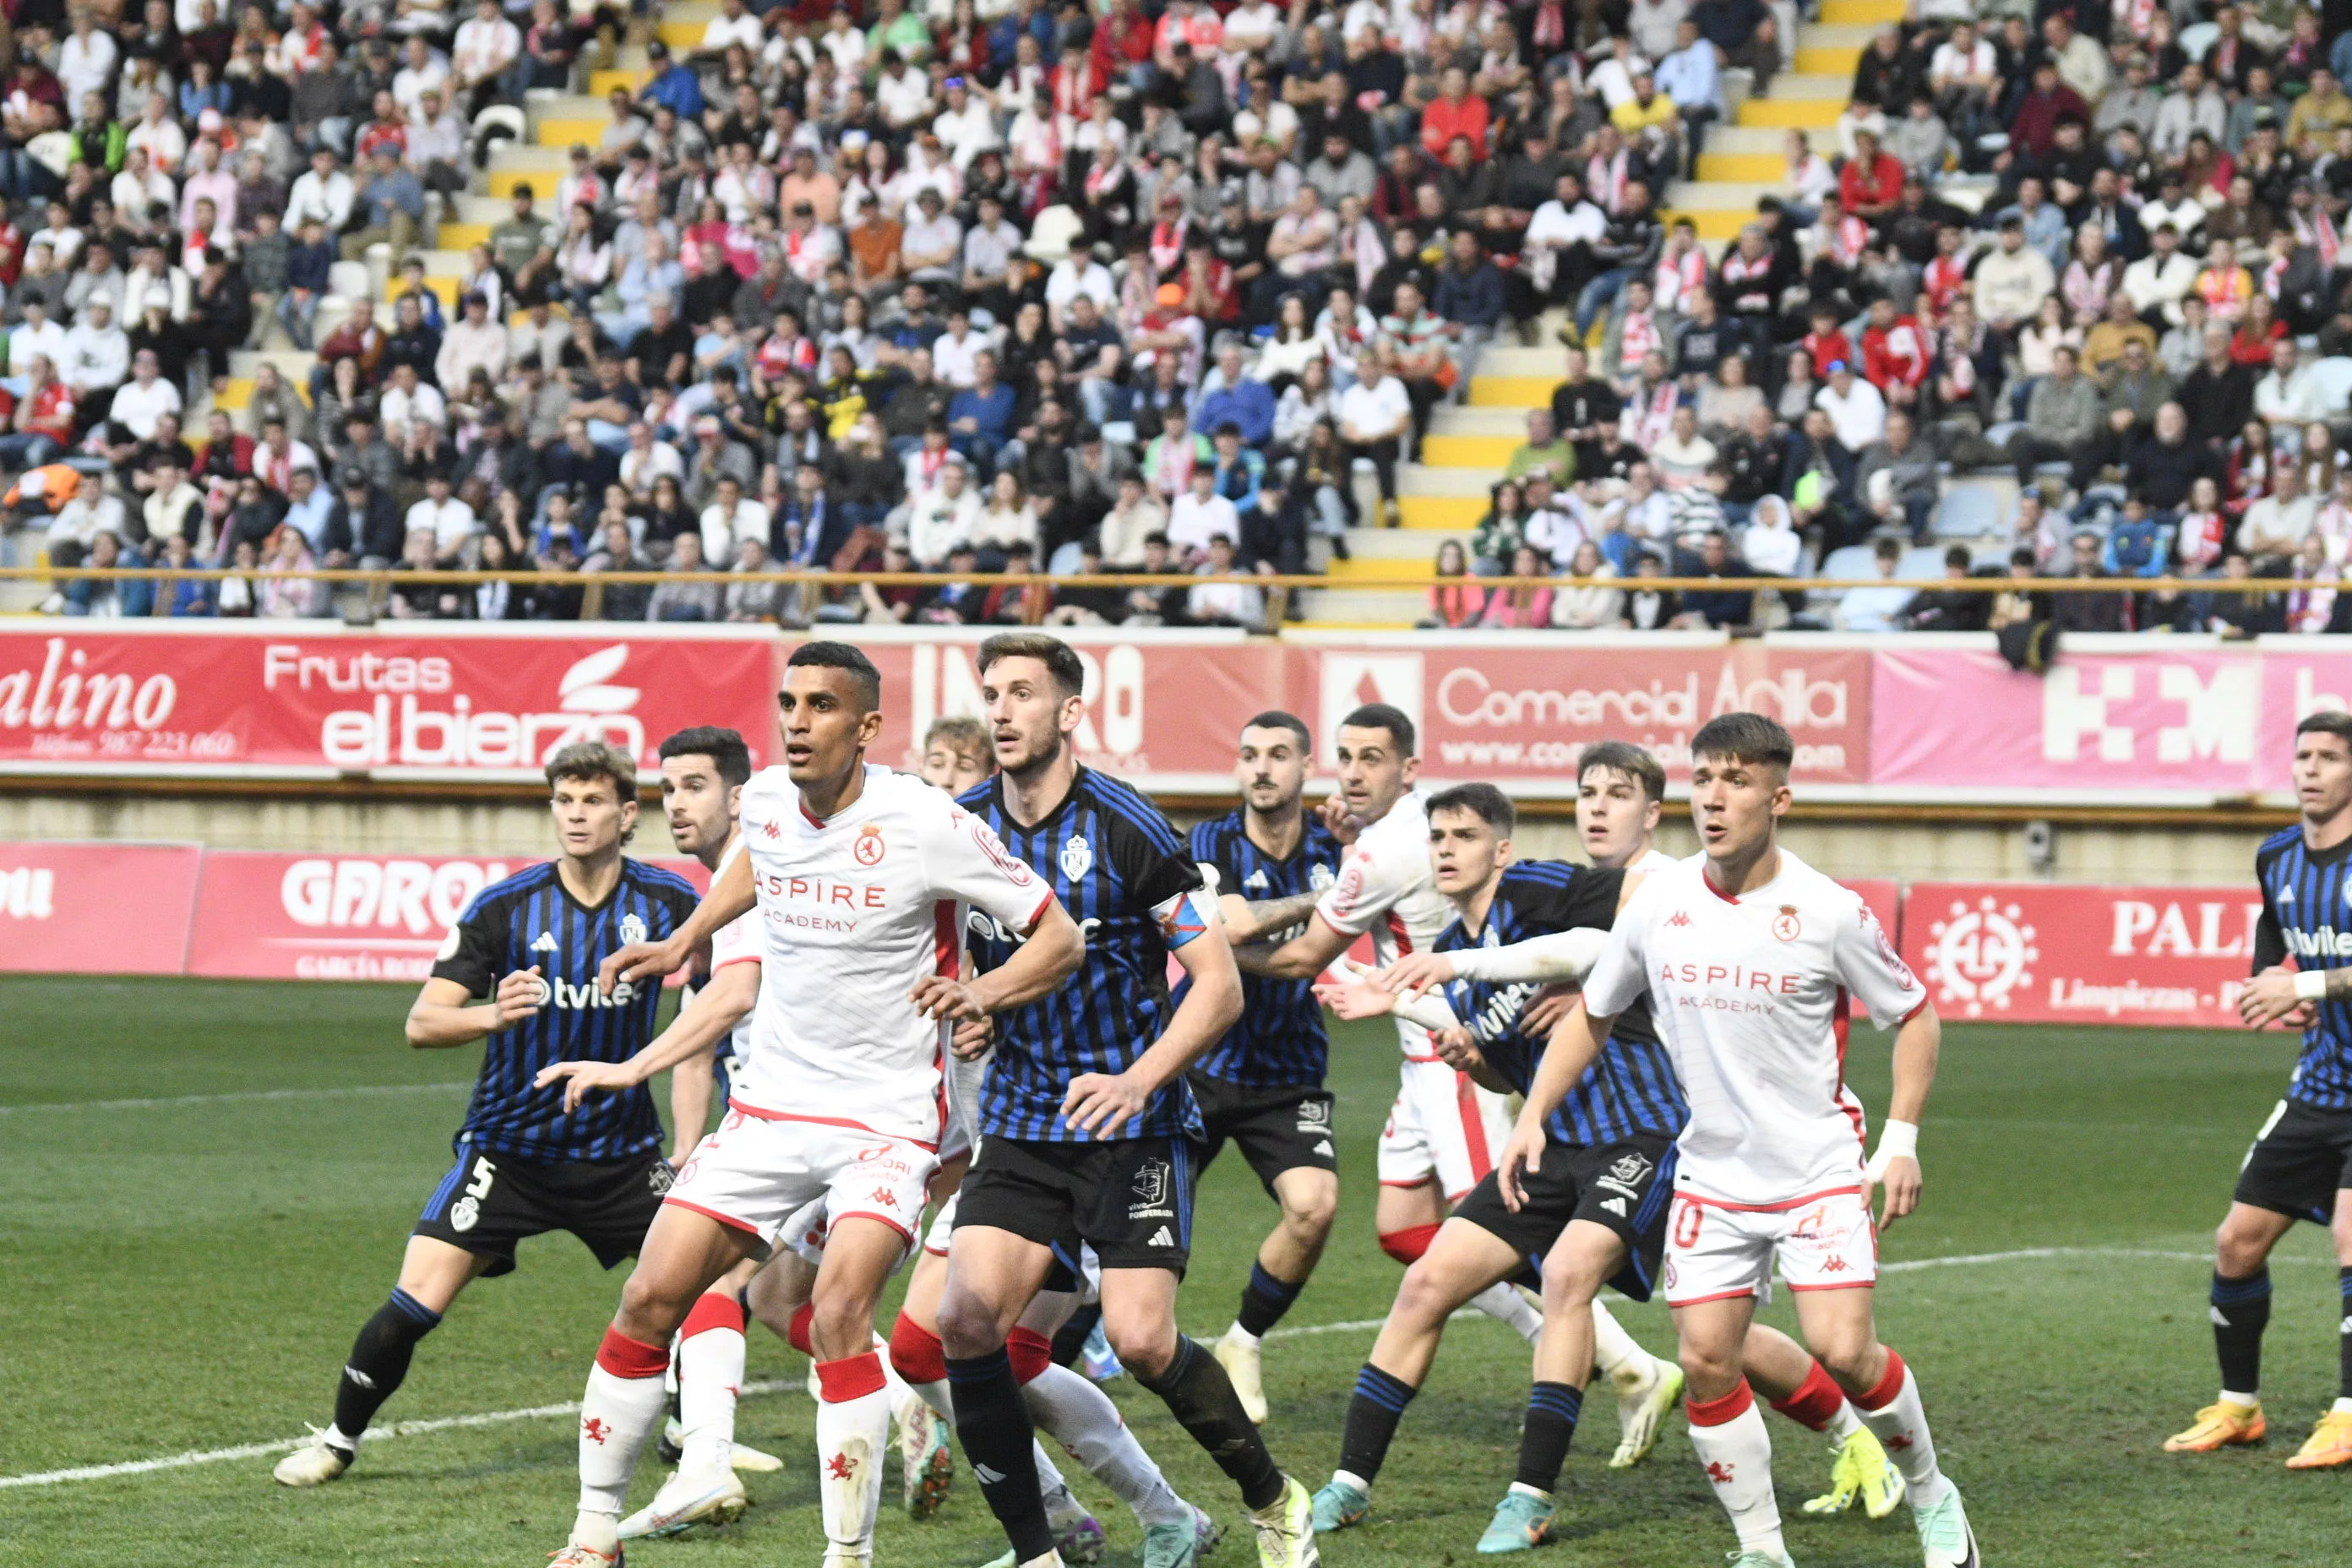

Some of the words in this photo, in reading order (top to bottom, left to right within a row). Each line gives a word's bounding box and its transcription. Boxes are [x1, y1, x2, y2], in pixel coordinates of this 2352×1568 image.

[264, 645, 453, 692] Frutas
[1437, 667, 1699, 727] Comercial
[281, 859, 509, 934] GARO
[764, 907, 858, 933] ACADEMY
[1661, 962, 1802, 996] ASPIRE
[1678, 994, 1776, 1015] ACADEMY
[466, 1156, 498, 1200] 5
